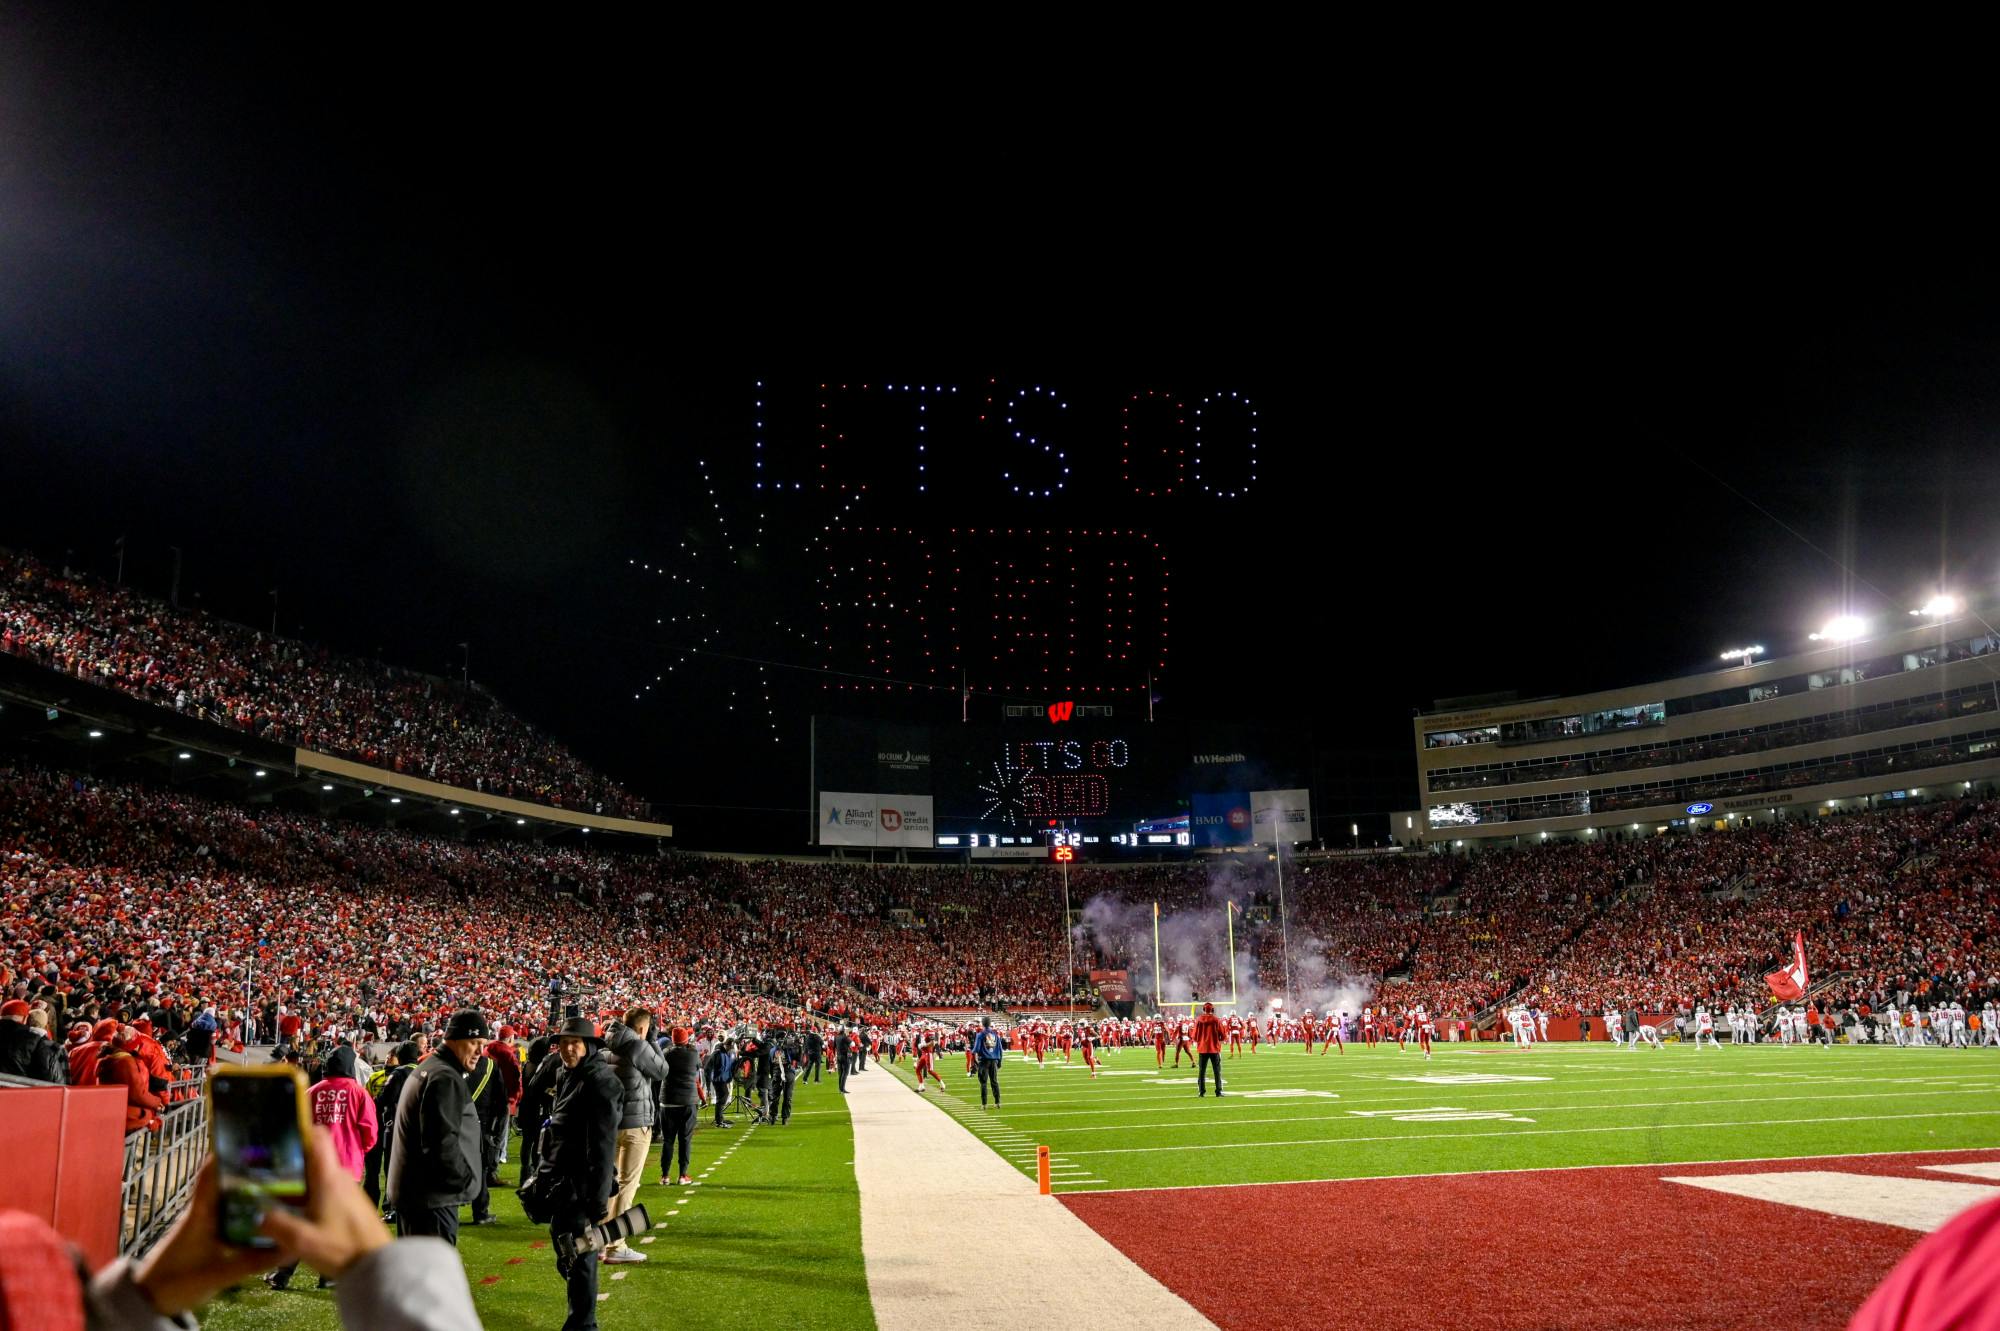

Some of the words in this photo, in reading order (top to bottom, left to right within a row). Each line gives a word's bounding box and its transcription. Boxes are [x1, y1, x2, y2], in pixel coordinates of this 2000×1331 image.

[756, 376, 1071, 497] LET'S
[1123, 390, 1258, 498] GO
[1006, 739, 1082, 769] LET'S
[1093, 740, 1128, 768] GO
[845, 809, 873, 818] Alliant
[845, 818, 873, 828] Energy
[904, 816, 928, 824] credit
[1195, 815, 1223, 825] BMO
[970, 833, 979, 847] 3
[1177, 832, 1189, 846] 10
[1055, 846, 1073, 861] 25
[316, 1089, 348, 1102] CSC
[315, 1103, 348, 1113] EVENT
[316, 1113, 345, 1124] STAFF
